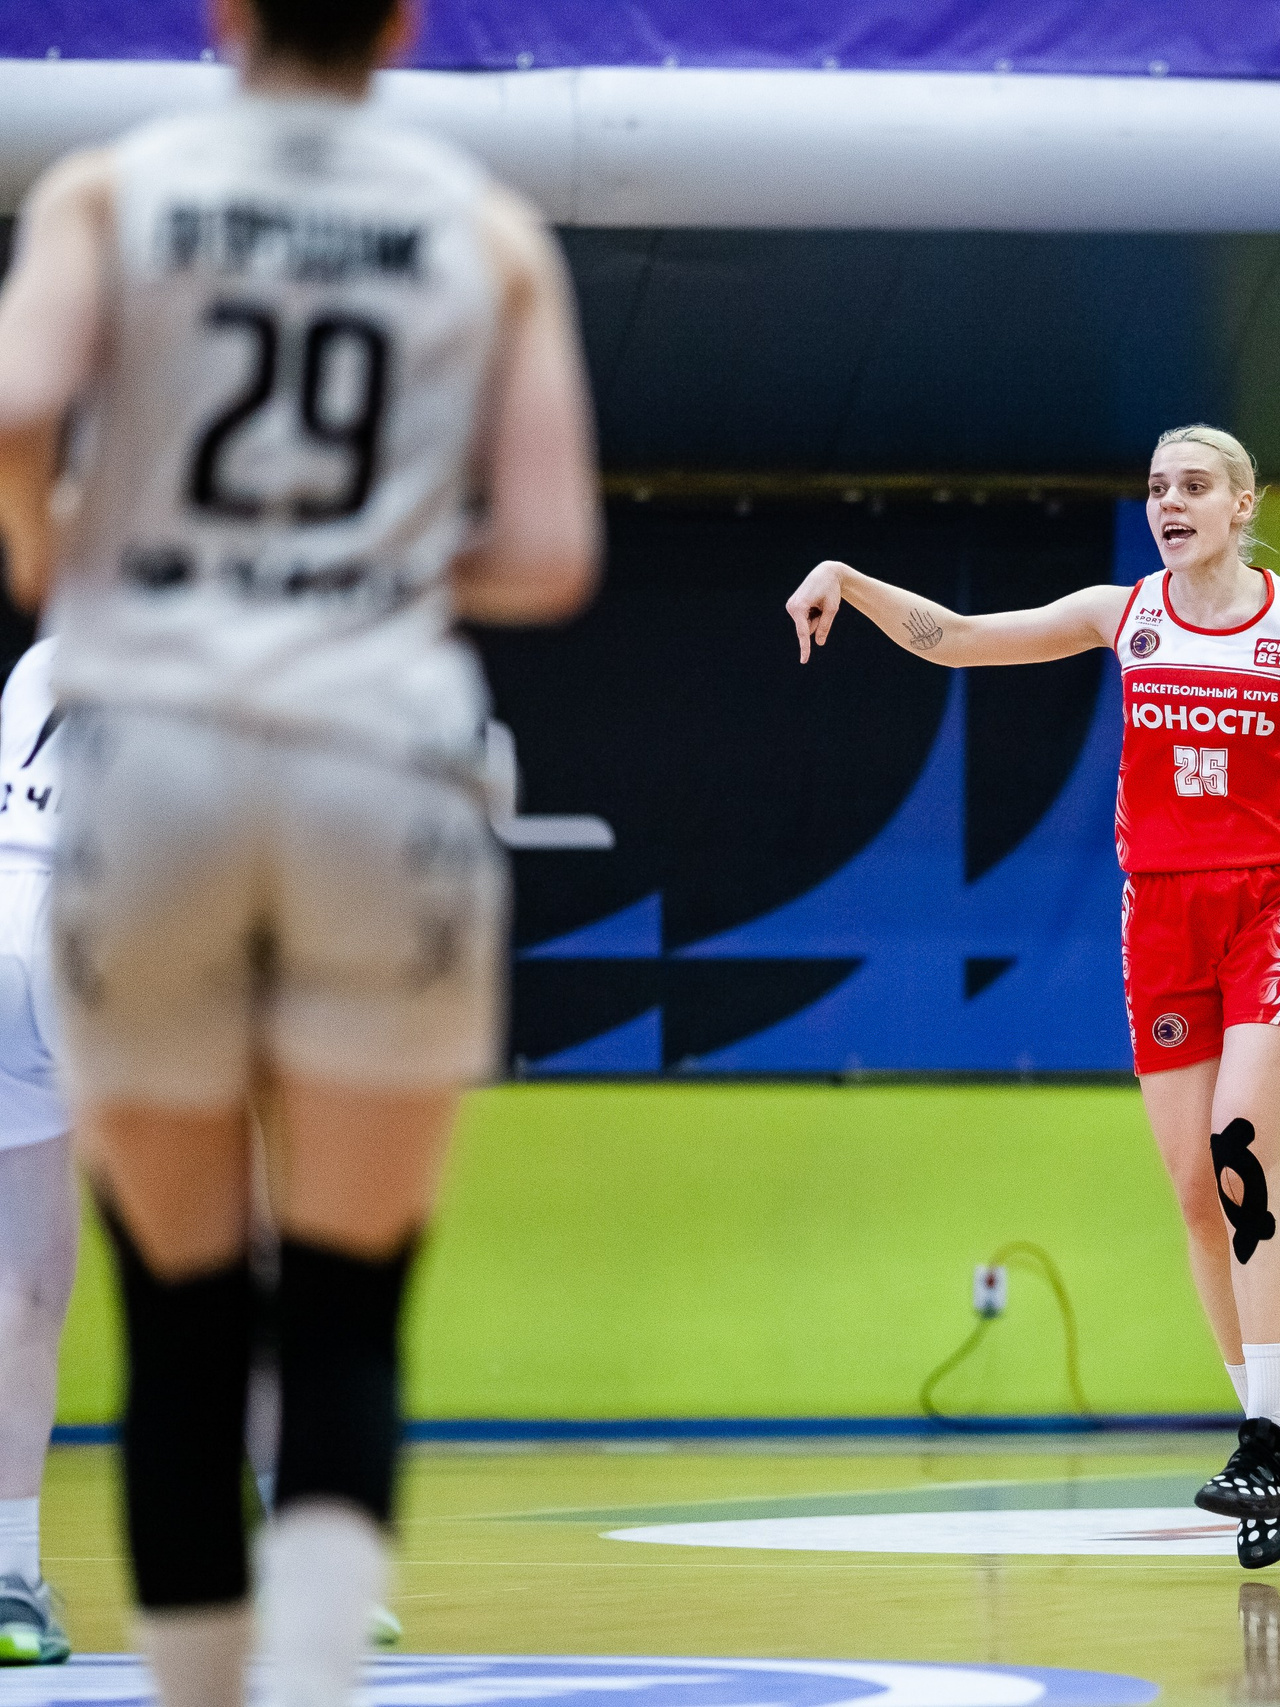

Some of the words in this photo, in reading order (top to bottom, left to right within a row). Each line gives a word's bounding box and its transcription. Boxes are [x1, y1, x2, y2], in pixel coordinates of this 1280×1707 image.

[183, 294, 393, 521] 29
[1135, 615, 1163, 624] SPORT
[1132, 682, 1238, 699] БАСКЕТБОЛЬНЫЙ
[1243, 690, 1279, 703] КЛУБ
[1132, 703, 1276, 737] ЮНОСТЬ
[1173, 745, 1229, 797] 25
